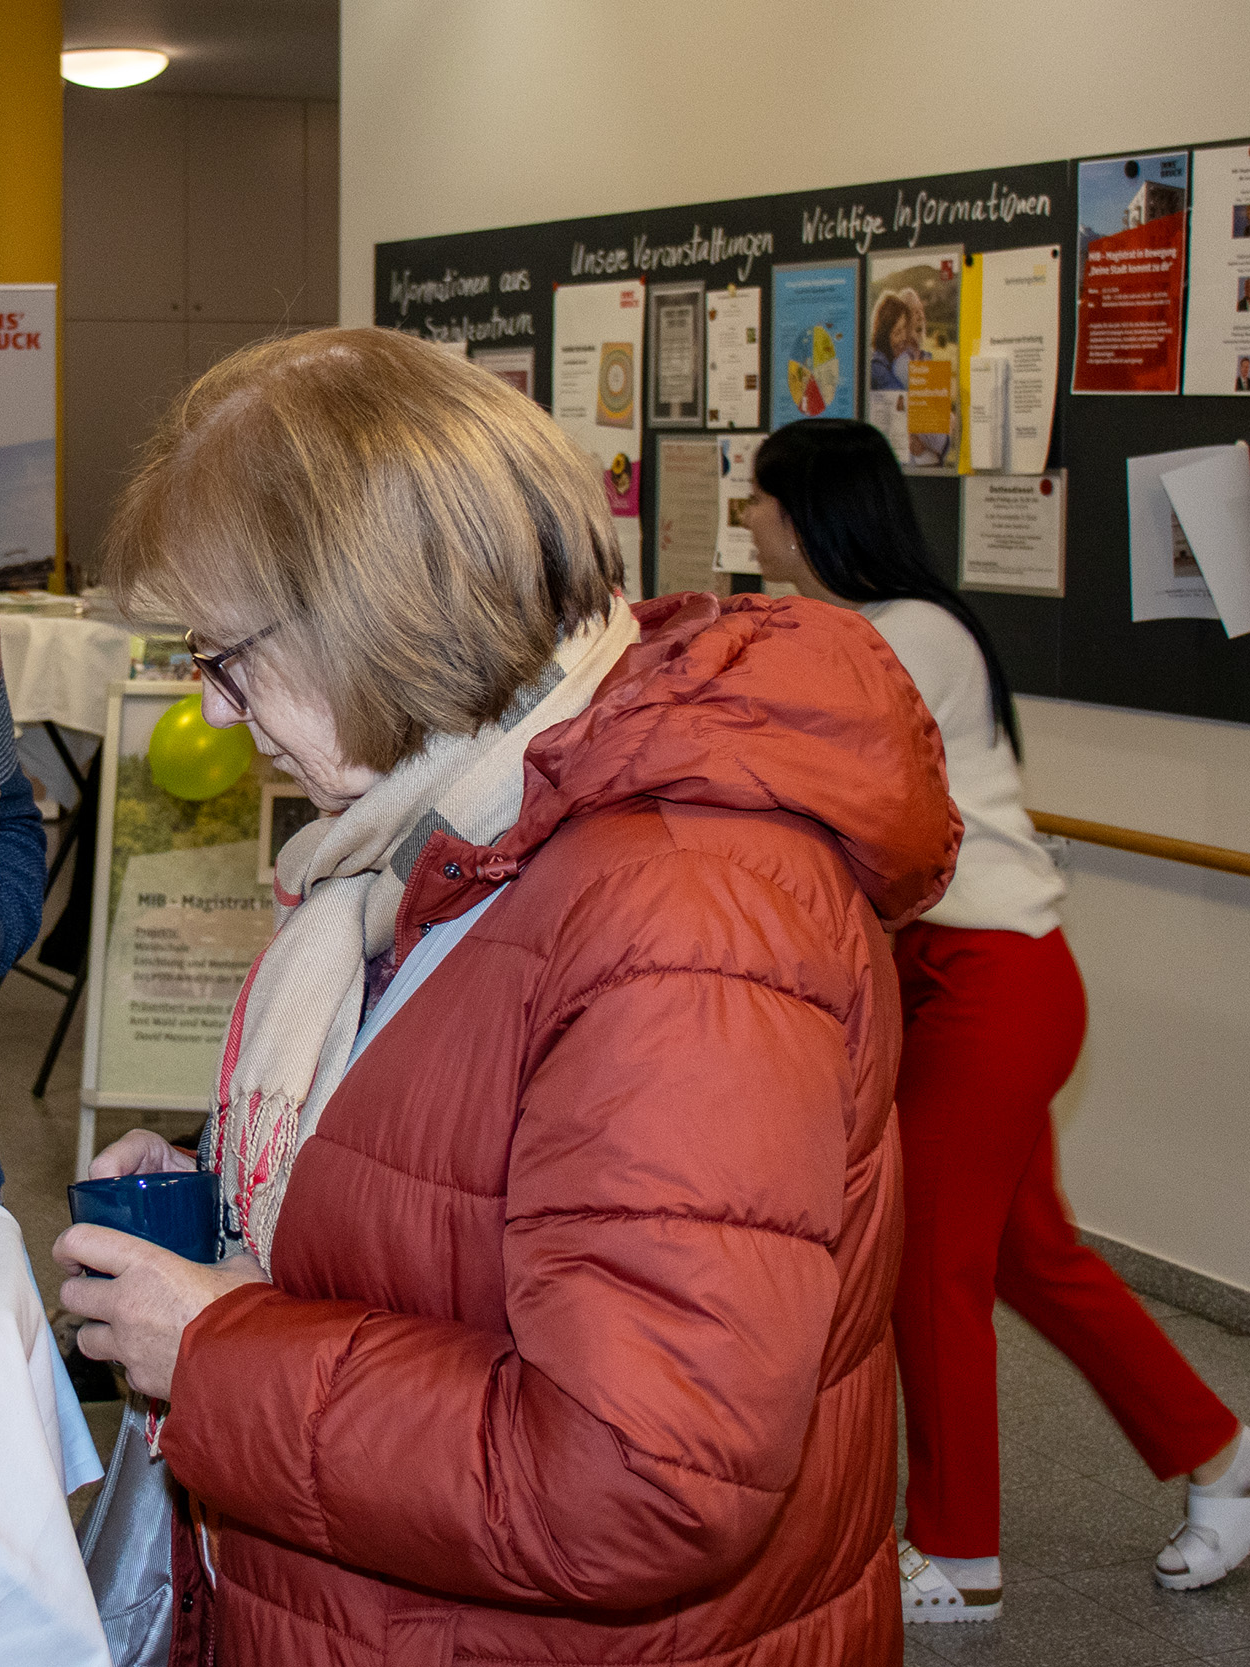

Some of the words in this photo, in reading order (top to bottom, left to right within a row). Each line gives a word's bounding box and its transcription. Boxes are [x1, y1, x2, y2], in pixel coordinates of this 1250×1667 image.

[802, 205, 886, 254] Wichtige
[893, 182, 1051, 248] Informationen
[571, 241, 629, 276] Unsere
[633, 224, 774, 282] Veranstaltungen
[499, 269, 531, 292] aus
[182, 893, 255, 914] Magistrat
